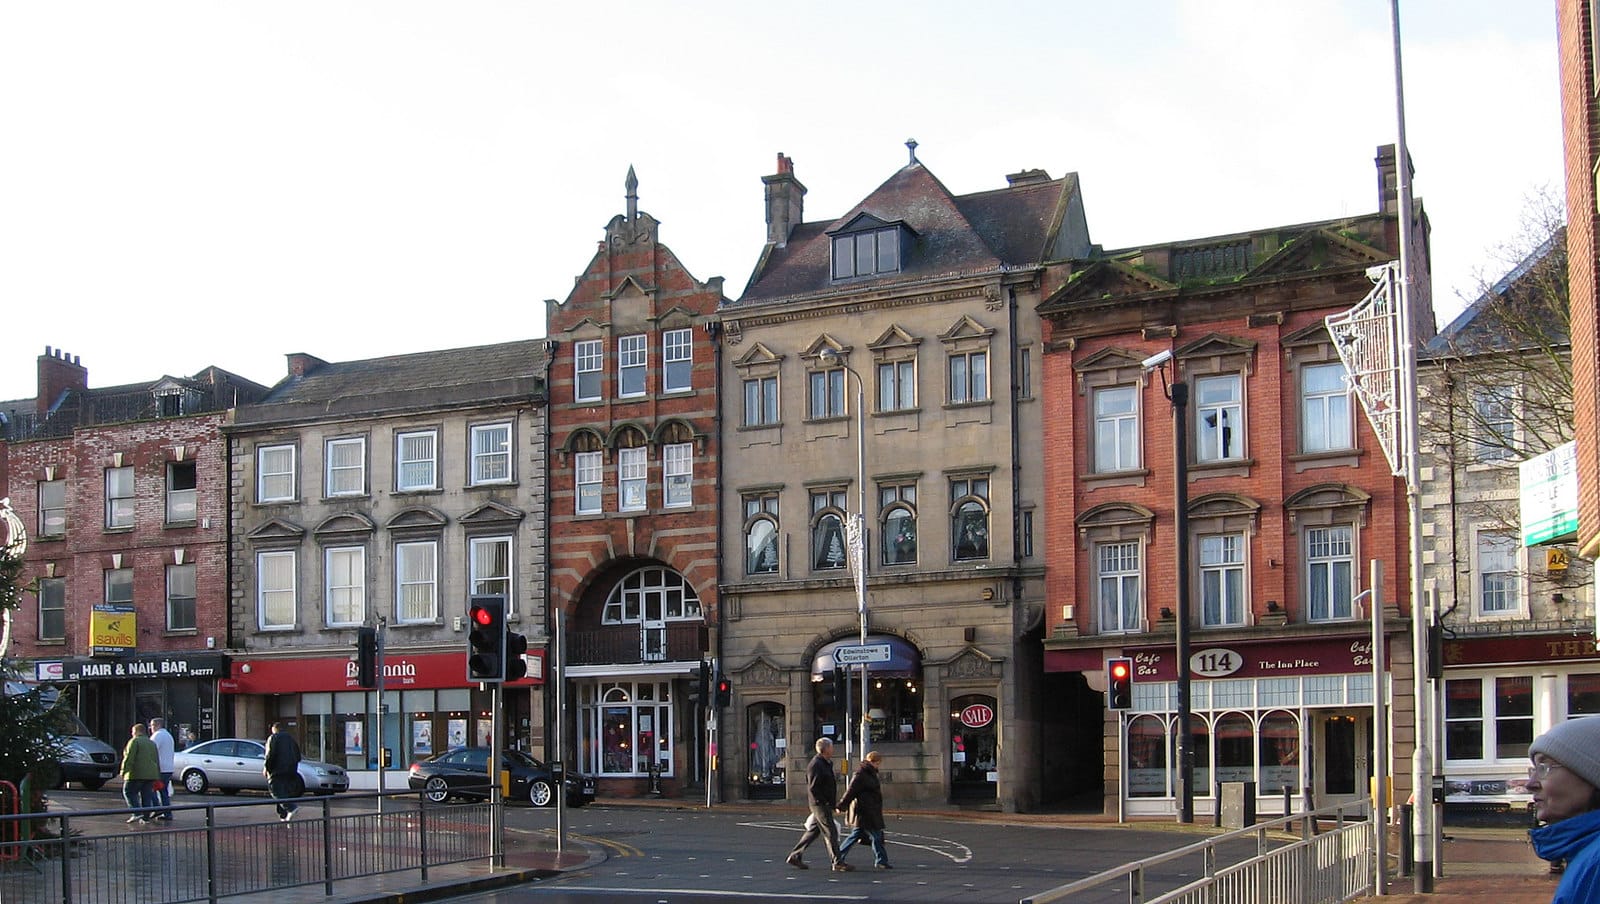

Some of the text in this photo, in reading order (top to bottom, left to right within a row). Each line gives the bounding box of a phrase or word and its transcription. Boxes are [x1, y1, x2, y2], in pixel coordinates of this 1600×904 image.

[96, 633, 133, 646] savills
[1350, 641, 1372, 653] Caf
[1135, 653, 1160, 665] Cafe
[1199, 653, 1232, 672] 114
[1259, 659, 1320, 669] The Inn Place
[82, 664, 112, 676] HAIR
[115, 663, 125, 676] &
[128, 662, 158, 674] NAIL
[161, 661, 187, 673] BAR
[1138, 665, 1157, 675] Bar
[965, 708, 988, 724] SALE
[1477, 783, 1500, 793] 108
